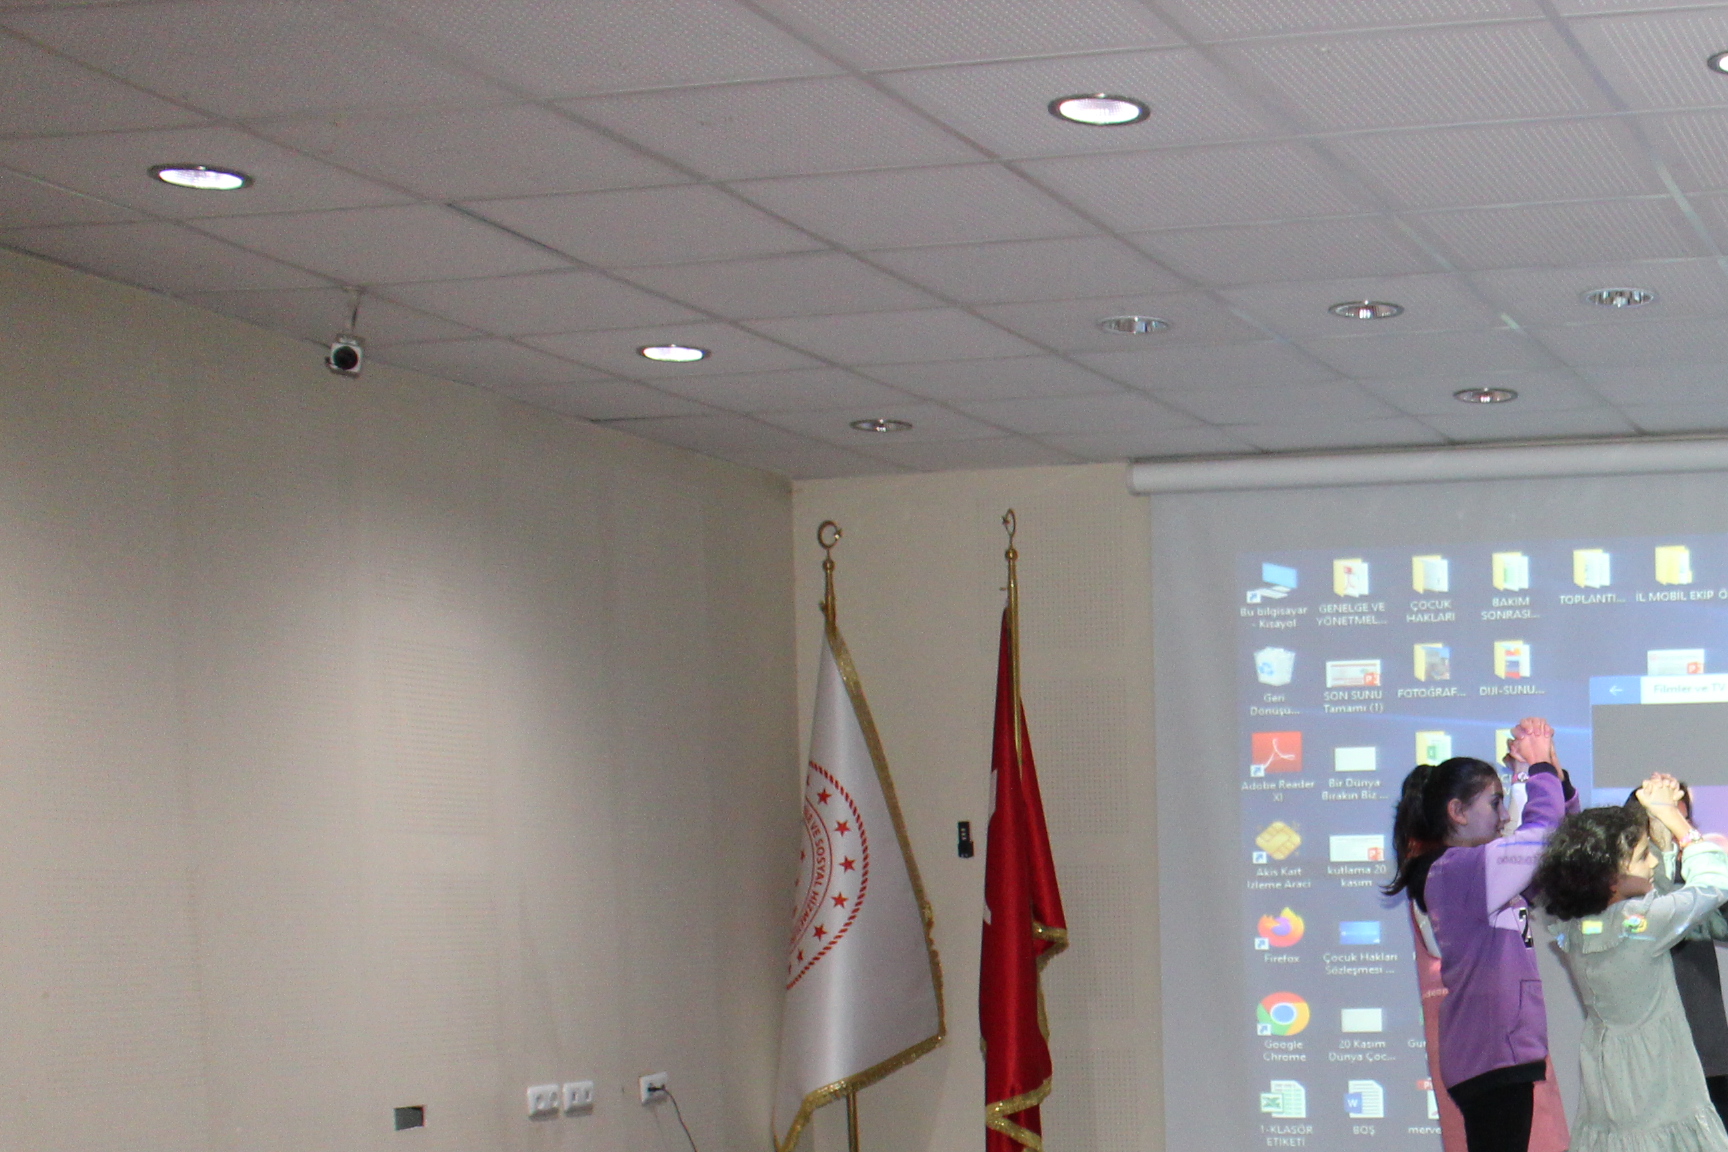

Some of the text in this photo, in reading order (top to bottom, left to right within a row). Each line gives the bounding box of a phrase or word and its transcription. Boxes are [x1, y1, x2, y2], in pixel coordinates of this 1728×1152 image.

[1410, 600, 1452, 611] ÇOCUK
[1492, 597, 1530, 607] BAKIM
[1319, 602, 1385, 614] GENELGE VE
[1406, 613, 1455, 623] HAKLARI
[1323, 690, 1382, 701] SON SUNU
[1327, 864, 1387, 875] kutlama 20
[1264, 953, 1300, 963] Firefox
[1323, 953, 1357, 964] Çocuk
[1264, 1040, 1303, 1051] Google
[1339, 1040, 1350, 1049] 20
[1263, 1052, 1306, 1062] Chrome
[1353, 1125, 1375, 1136] BOŞ
